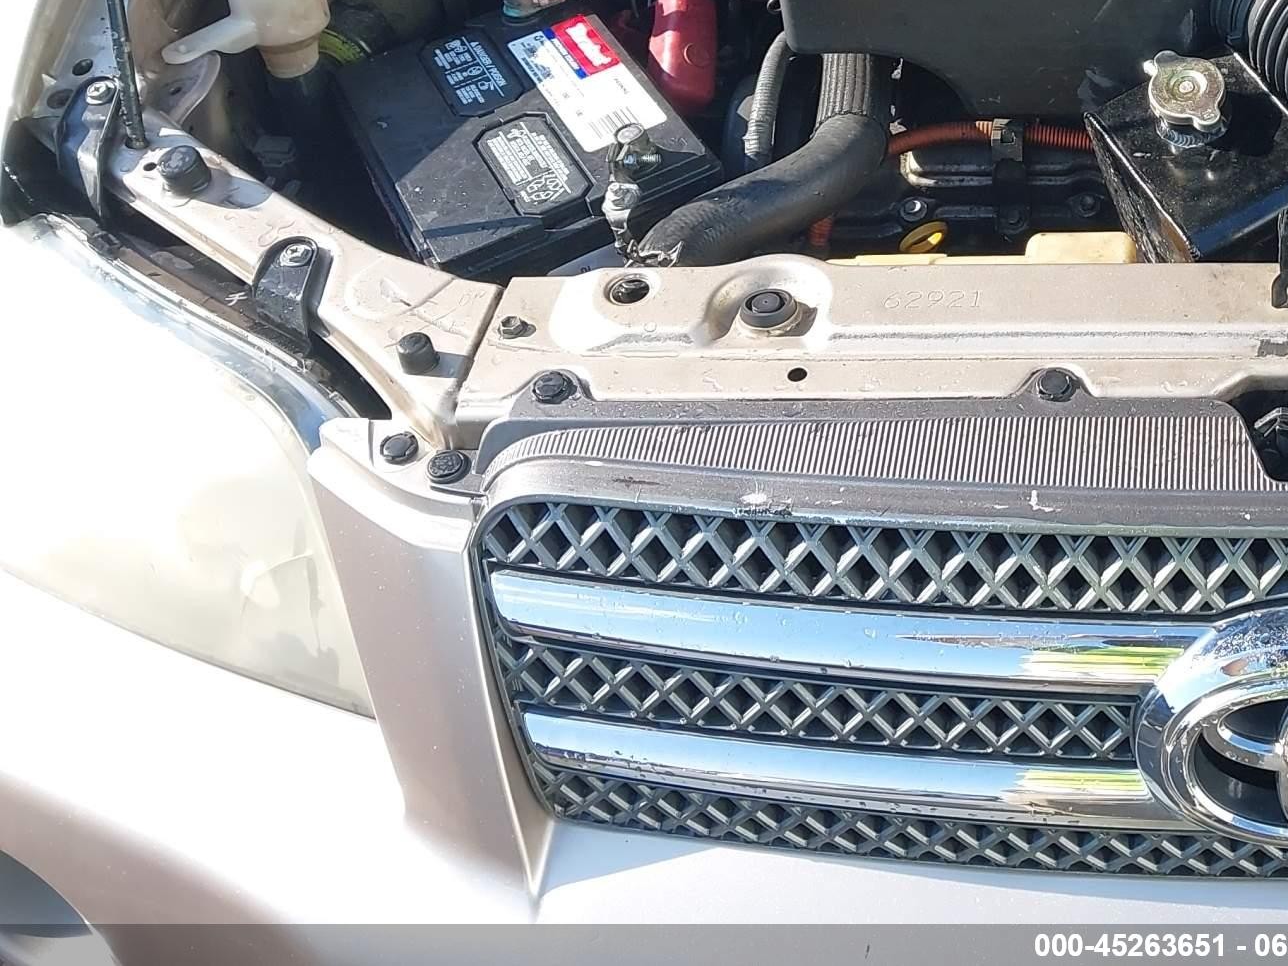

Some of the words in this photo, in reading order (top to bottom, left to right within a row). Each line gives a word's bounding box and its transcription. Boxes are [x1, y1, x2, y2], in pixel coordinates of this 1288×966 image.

[474, 44, 493, 65] DANGER
[488, 67, 507, 87] POISON
[883, 290, 981, 309] 62921
